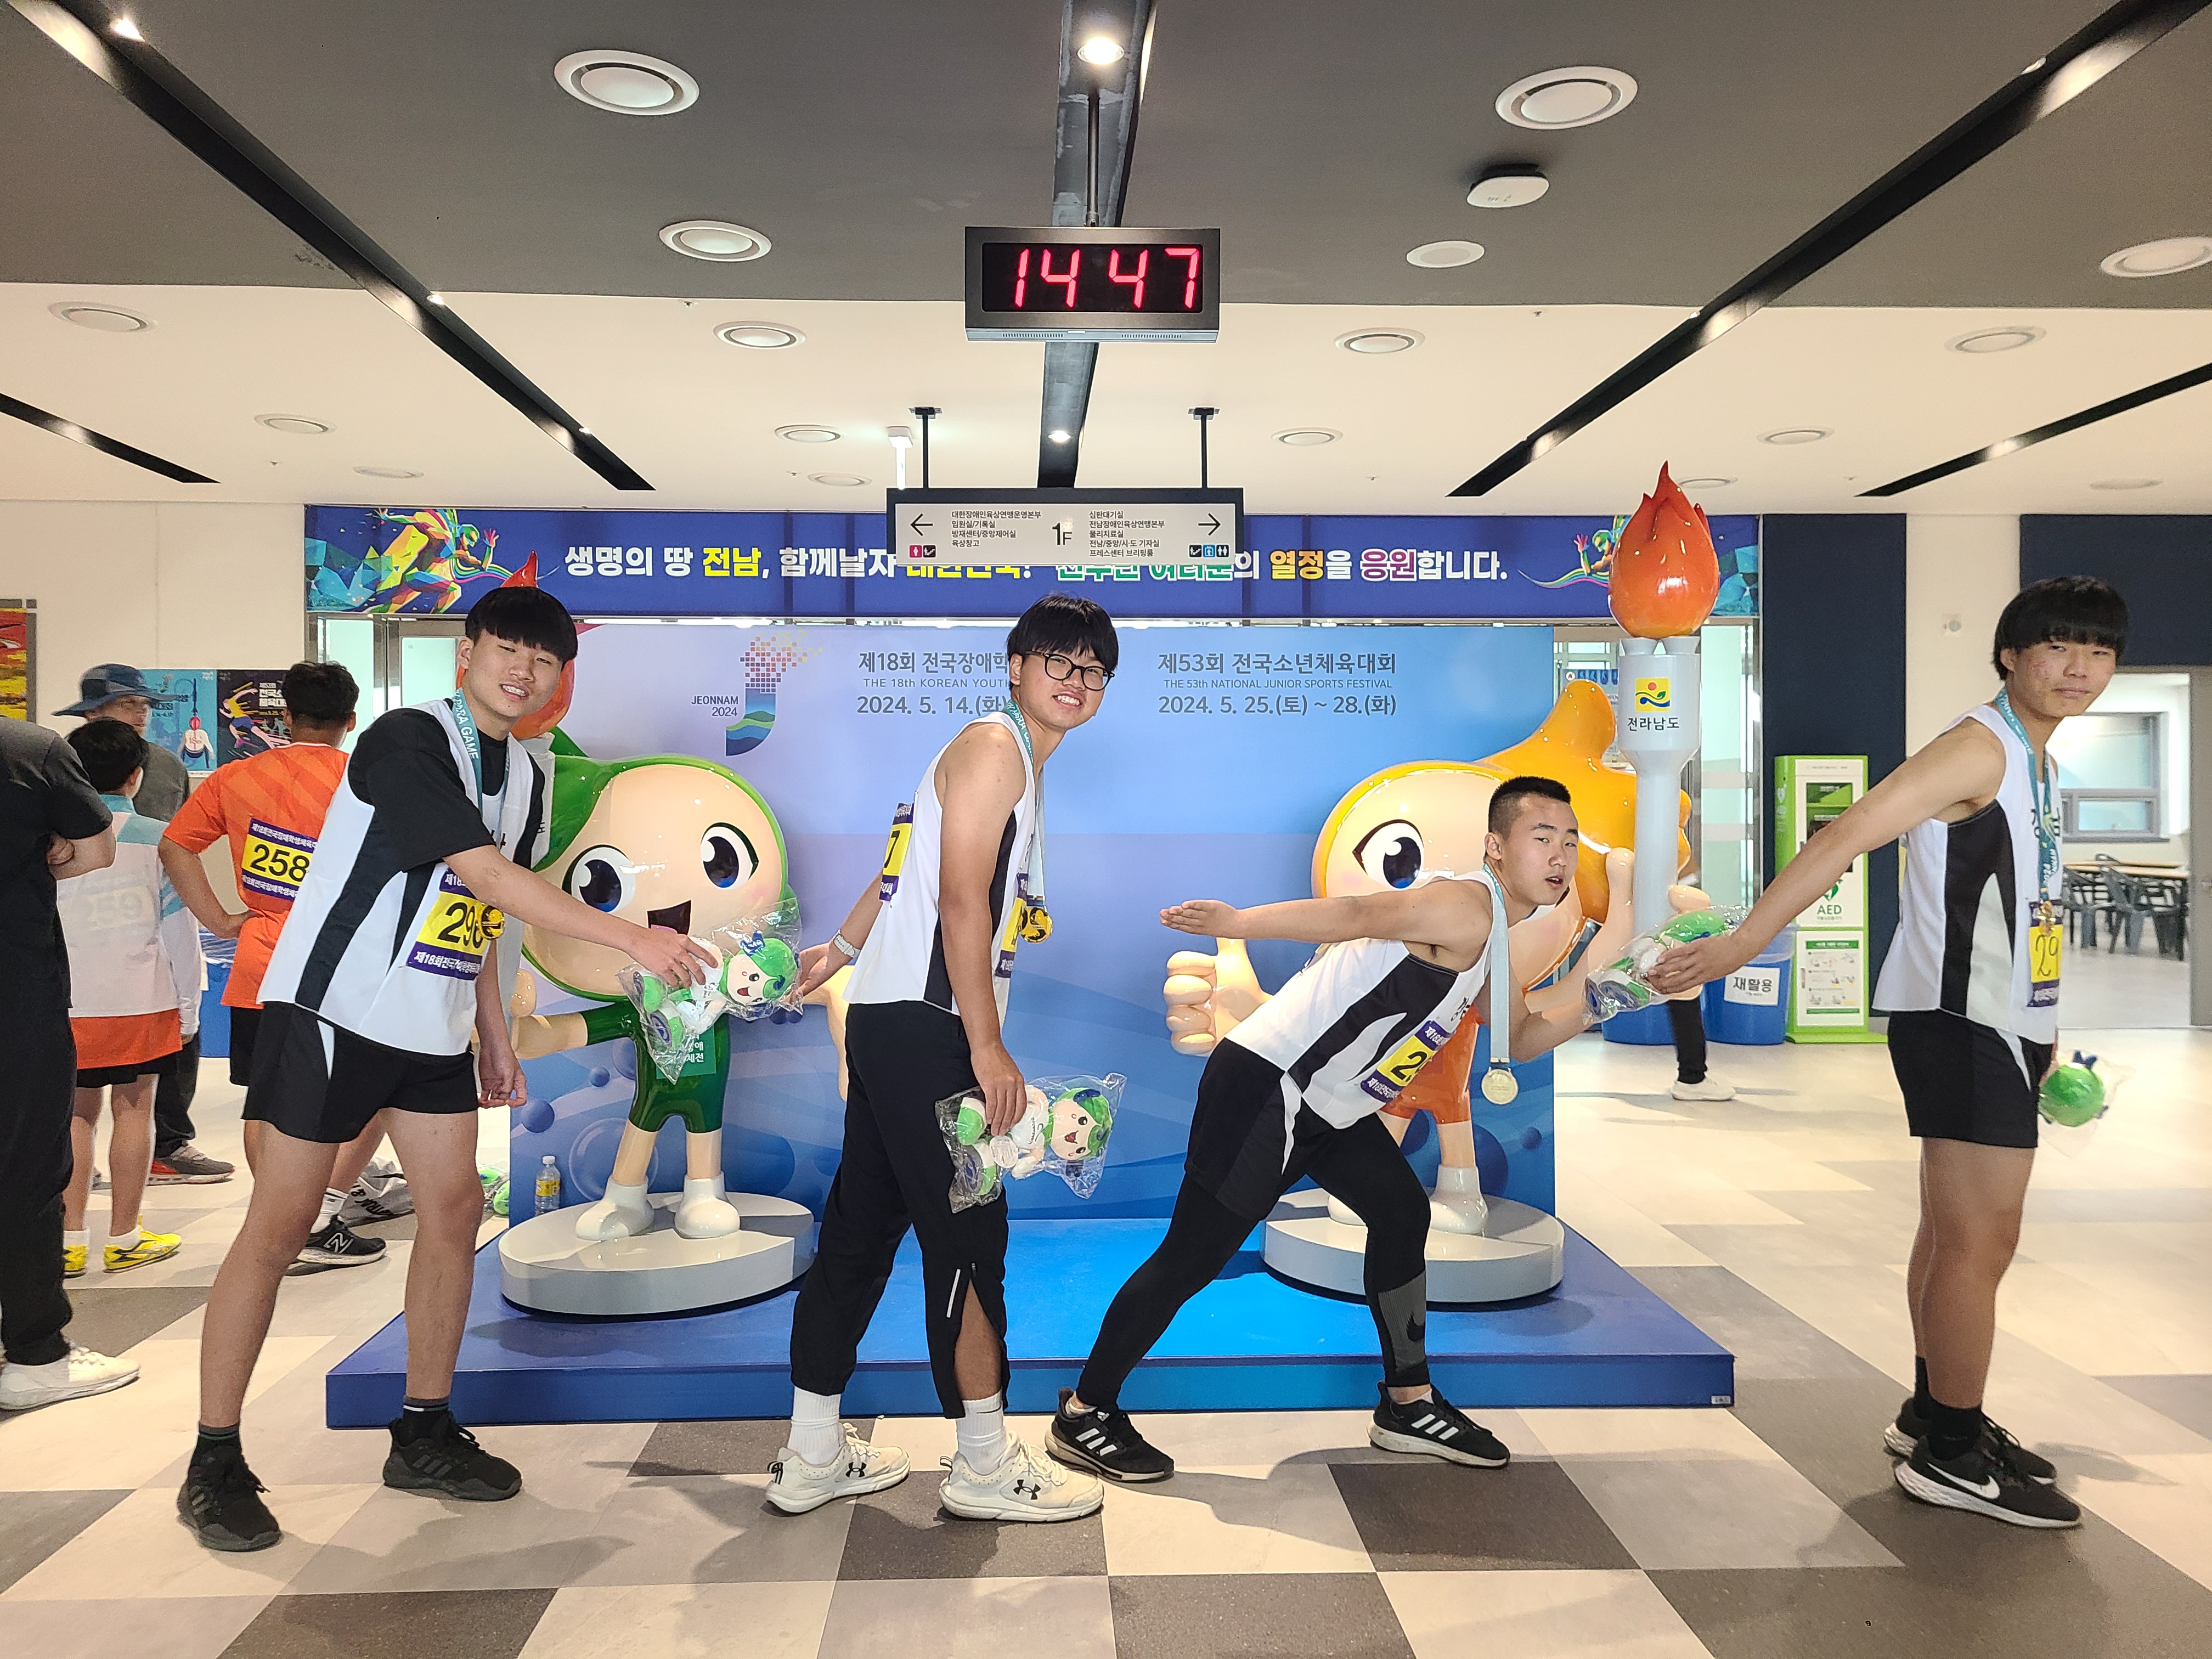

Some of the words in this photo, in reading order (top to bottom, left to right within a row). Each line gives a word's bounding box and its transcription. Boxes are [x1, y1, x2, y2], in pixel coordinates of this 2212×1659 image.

[952, 511, 1041, 519] 대한장애인육상연맹운영본부
[1089, 511, 1124, 519] 심판대기실
[952, 530, 1016, 538] 방재센터/중앙제어실
[1052, 523, 1073, 545] 1F
[1089, 530, 1124, 538] 물리치료실
[1139, 539, 1160, 548] 기자실
[1089, 549, 1124, 557] 프레스센터
[1126, 549, 1154, 557] 브리핑룸
[565, 546, 652, 577] 생명의
[664, 546, 693, 577] 땅
[703, 547, 769, 579] 전남,
[779, 547, 896, 578] 함께날자
[1269, 549, 1353, 581] 열정을
[1359, 549, 1508, 582] 응원합니다.
[859, 652, 916, 673] 제18회
[1158, 653, 1223, 674] 제53회
[1232, 653, 1396, 674] 전국소년체육대회
[864, 679, 887, 687] THE
[891, 678, 916, 687] 18th
[920, 679, 967, 687] KOREAN
[1164, 679, 1183, 688] THE
[1187, 679, 1208, 688] 53th
[1211, 679, 1261, 688] NATIONAL
[1264, 679, 1301, 688] JUNIOR
[1305, 679, 1344, 688] SPORTS
[1347, 679, 1392, 688] FESTIVAL
[691, 696, 739, 705] JEONNAM
[857, 696, 912, 714] 2024.
[919, 696, 936, 714] 5.
[1159, 696, 1213, 714] 2024.
[1220, 696, 1237, 714] 5.
[1244, 695, 1308, 716] 25.(토)
[1333, 695, 1397, 716] 28.(화)
[712, 707, 738, 716] 2024
[1627, 716, 1680, 732] 전라남도
[250, 844, 310, 882] 258
[1817, 905, 1842, 915] AED
